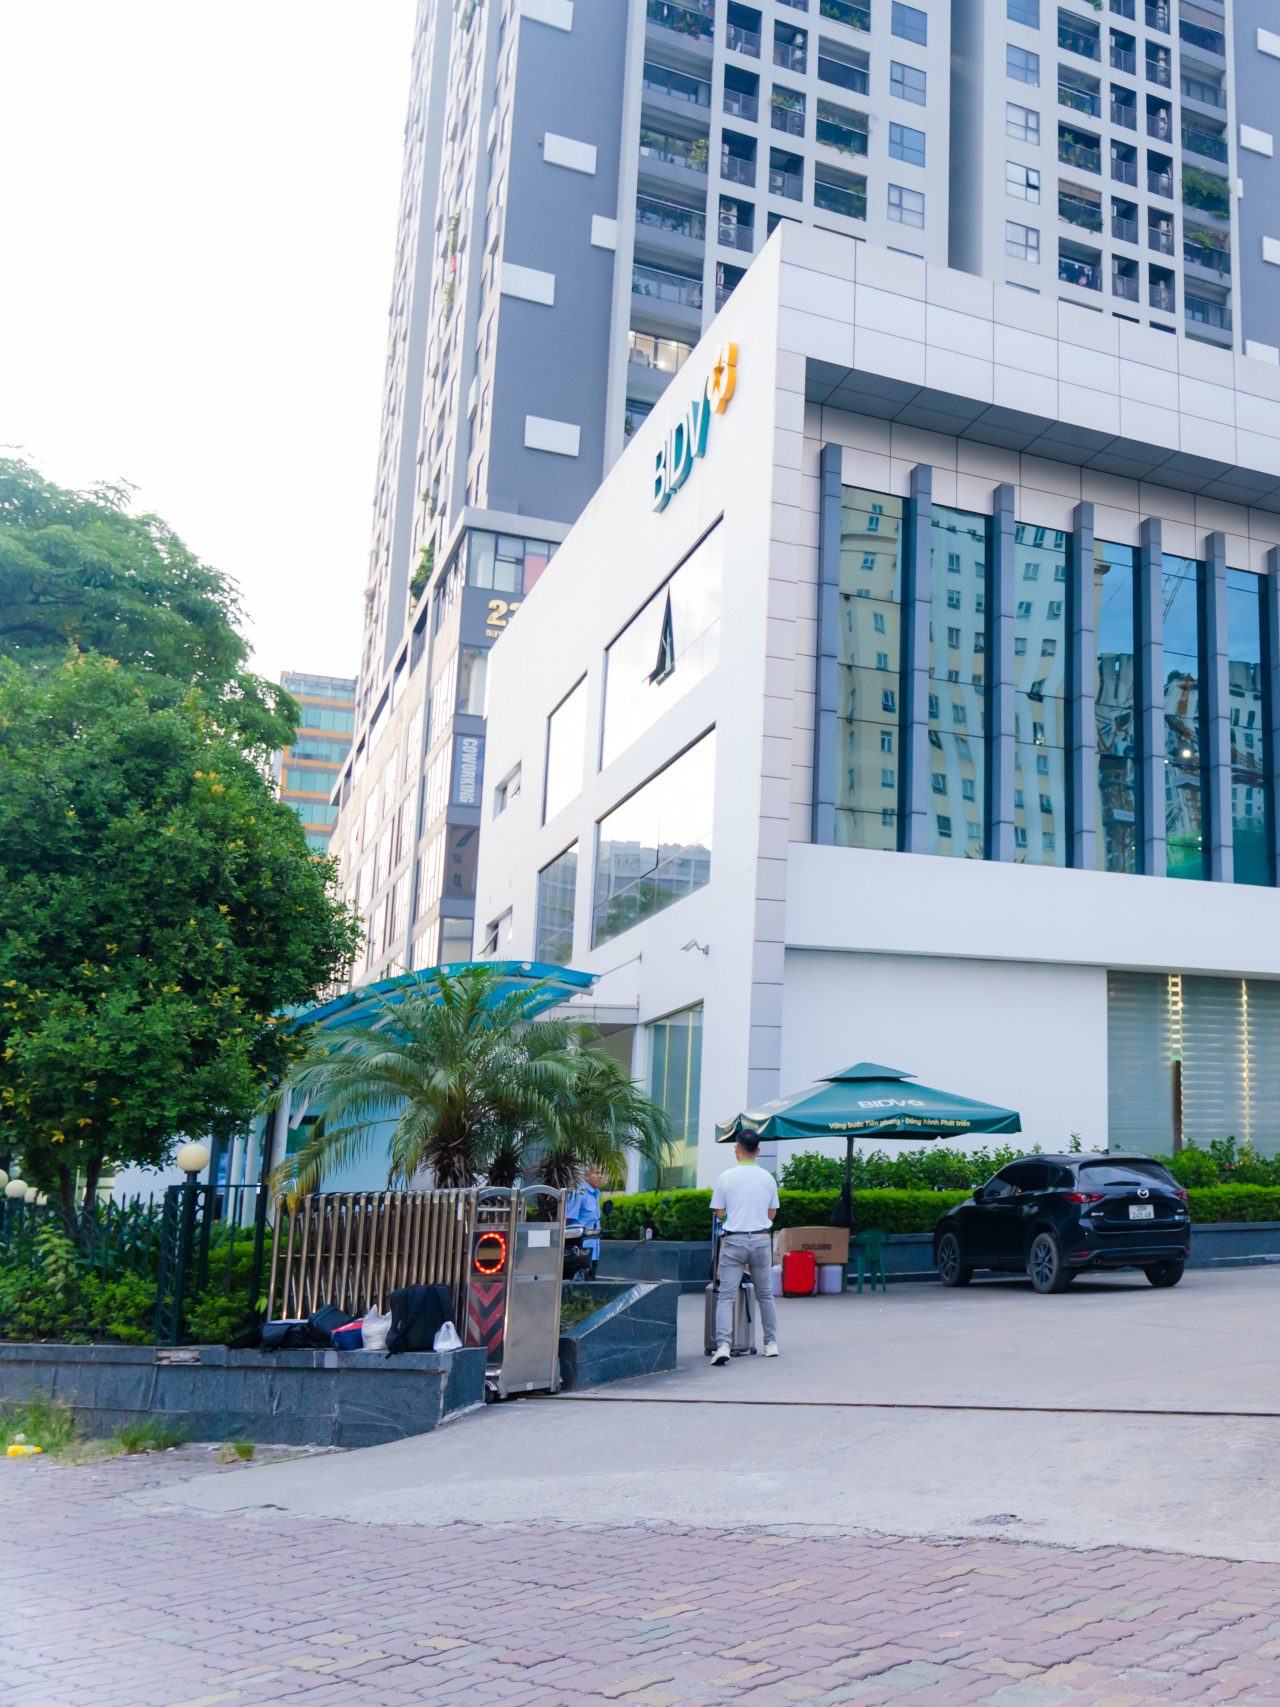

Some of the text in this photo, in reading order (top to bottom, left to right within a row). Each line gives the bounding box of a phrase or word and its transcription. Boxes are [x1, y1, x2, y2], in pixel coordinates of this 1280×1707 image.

[652, 376, 711, 514] BIDV
[459, 738, 478, 804] COWORKING
[857, 1098, 906, 1108] BIDV
